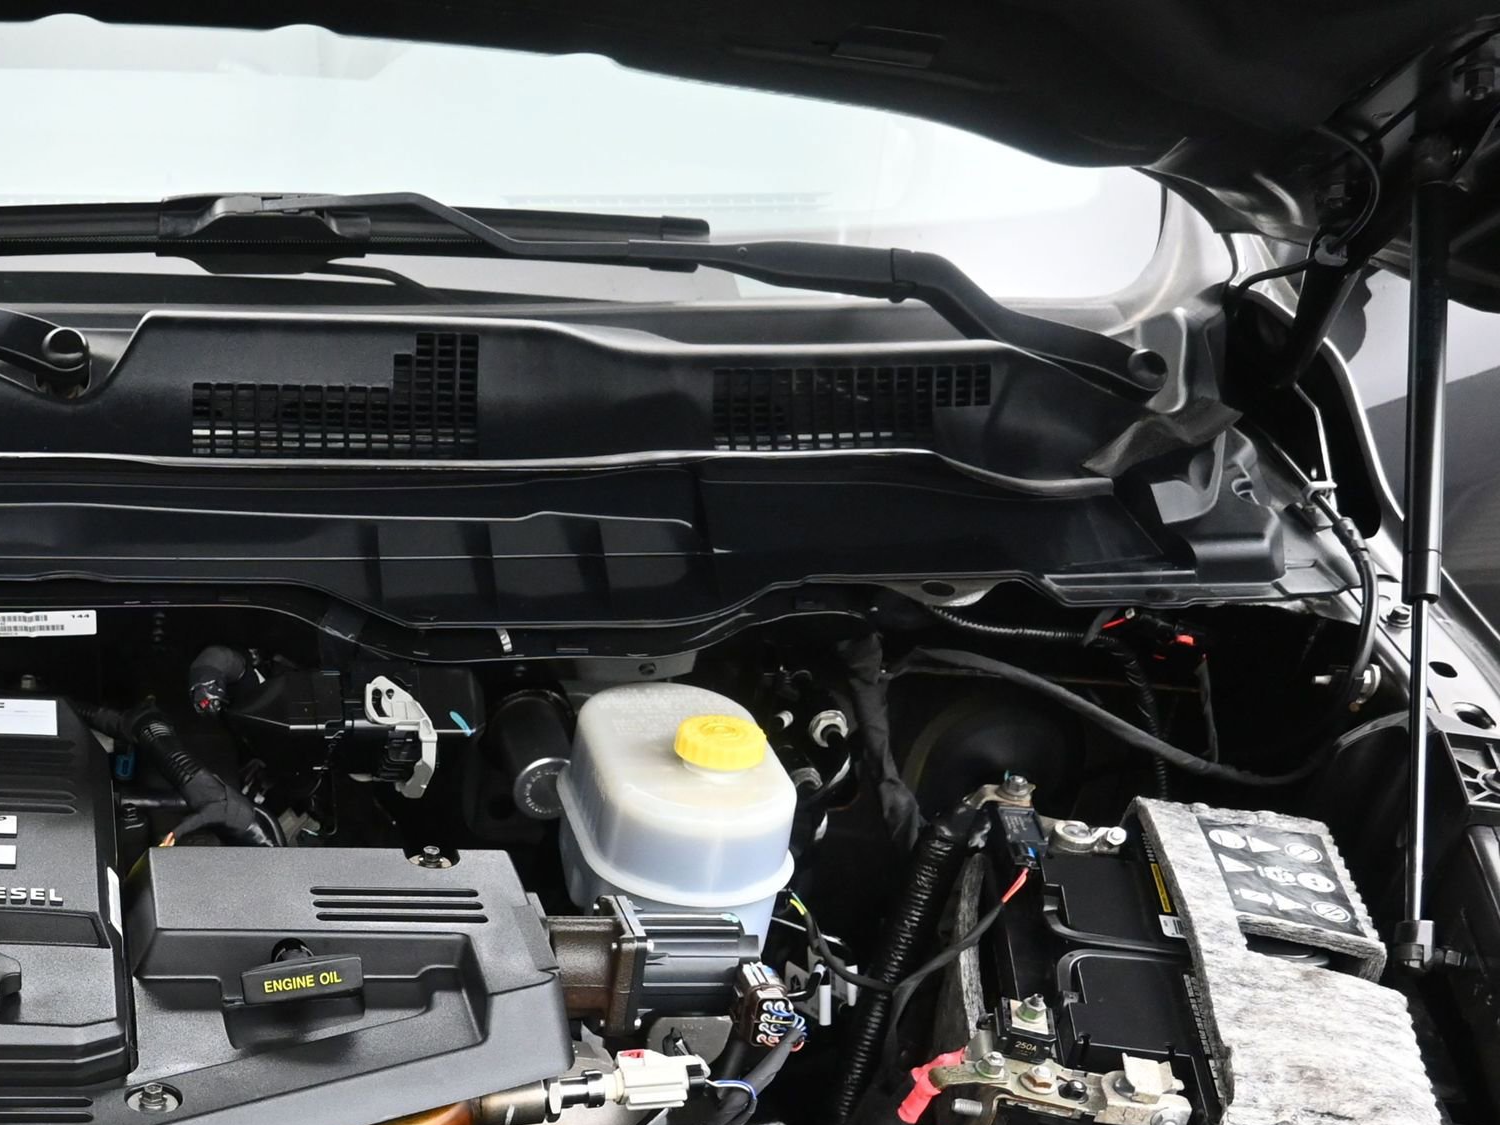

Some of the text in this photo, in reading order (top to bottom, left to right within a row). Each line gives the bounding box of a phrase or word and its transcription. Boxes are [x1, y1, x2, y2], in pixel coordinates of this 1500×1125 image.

[263, 971, 342, 993] ENGINE OIL
[1015, 1040, 1037, 1052] 250A
